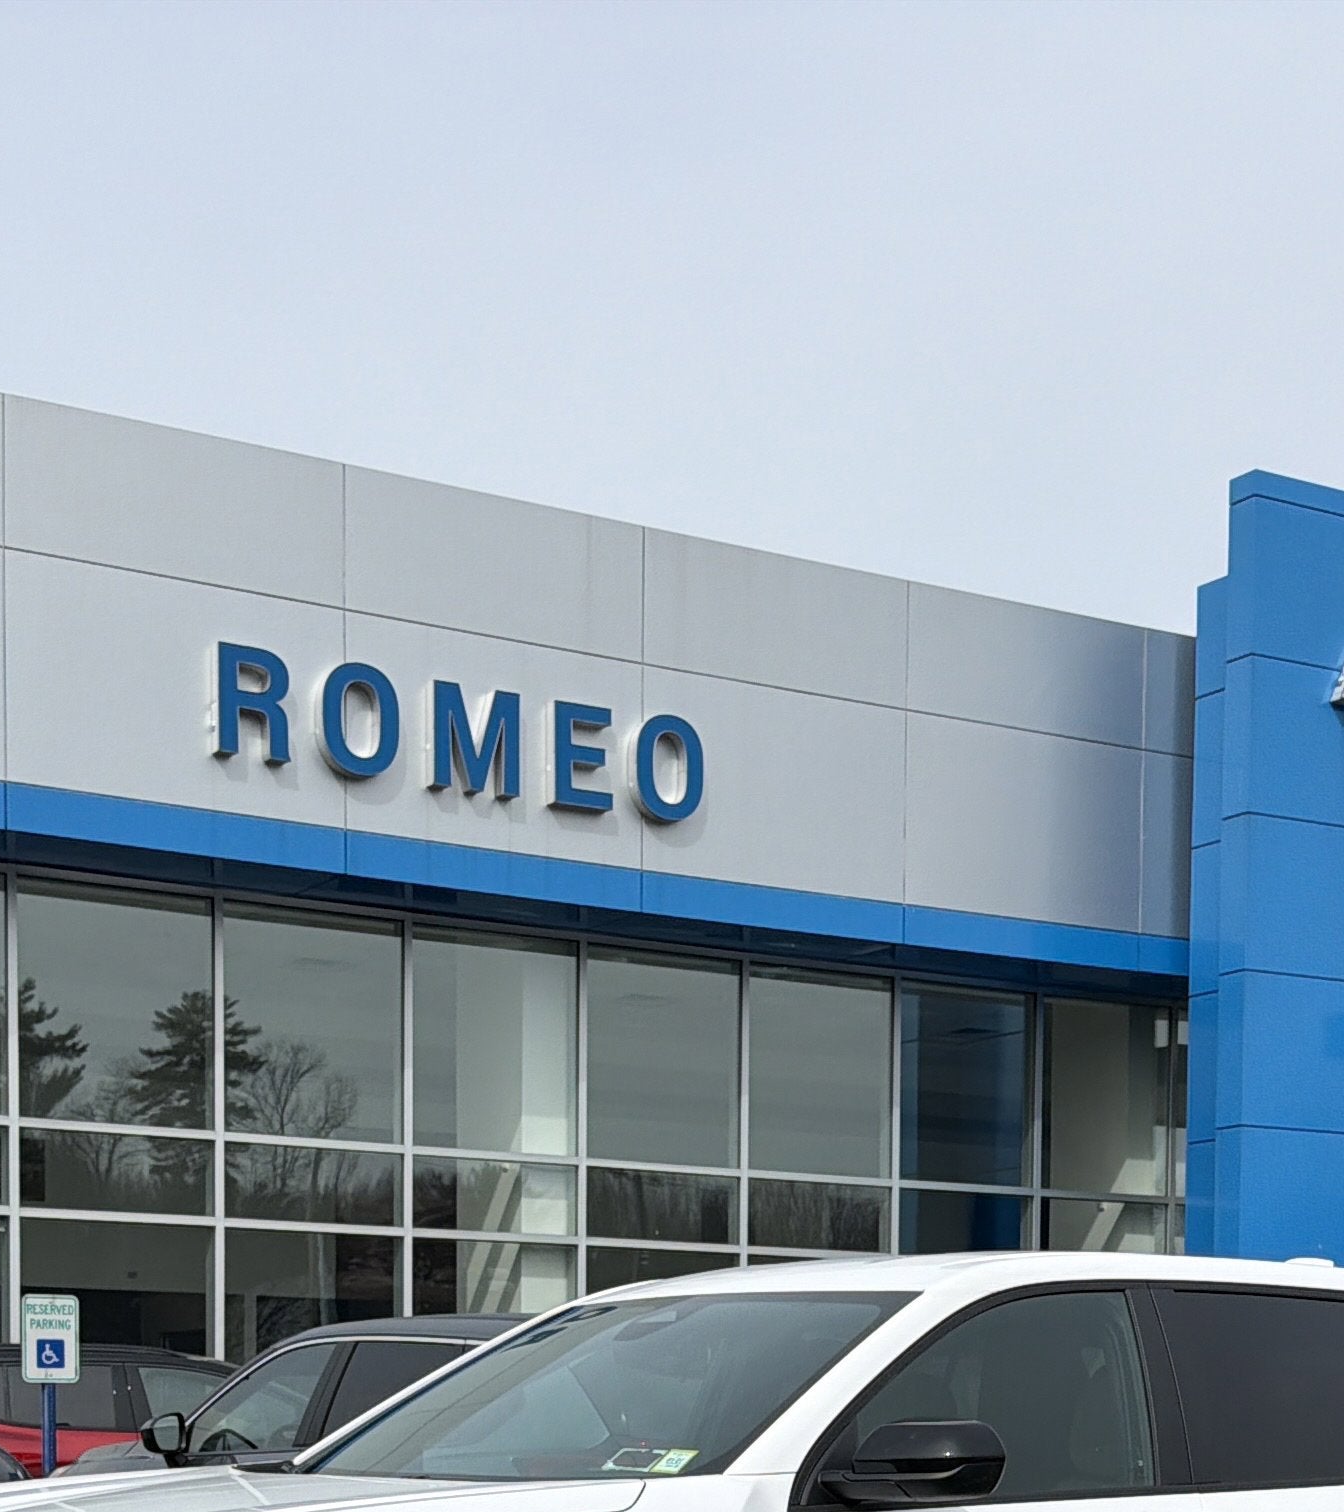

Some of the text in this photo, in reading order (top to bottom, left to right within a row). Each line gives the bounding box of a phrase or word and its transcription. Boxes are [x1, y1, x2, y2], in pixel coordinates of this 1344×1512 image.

[212, 641, 704, 823] ROMEO
[26, 1303, 74, 1316] RESERVED
[29, 1318, 71, 1331] PARKING
